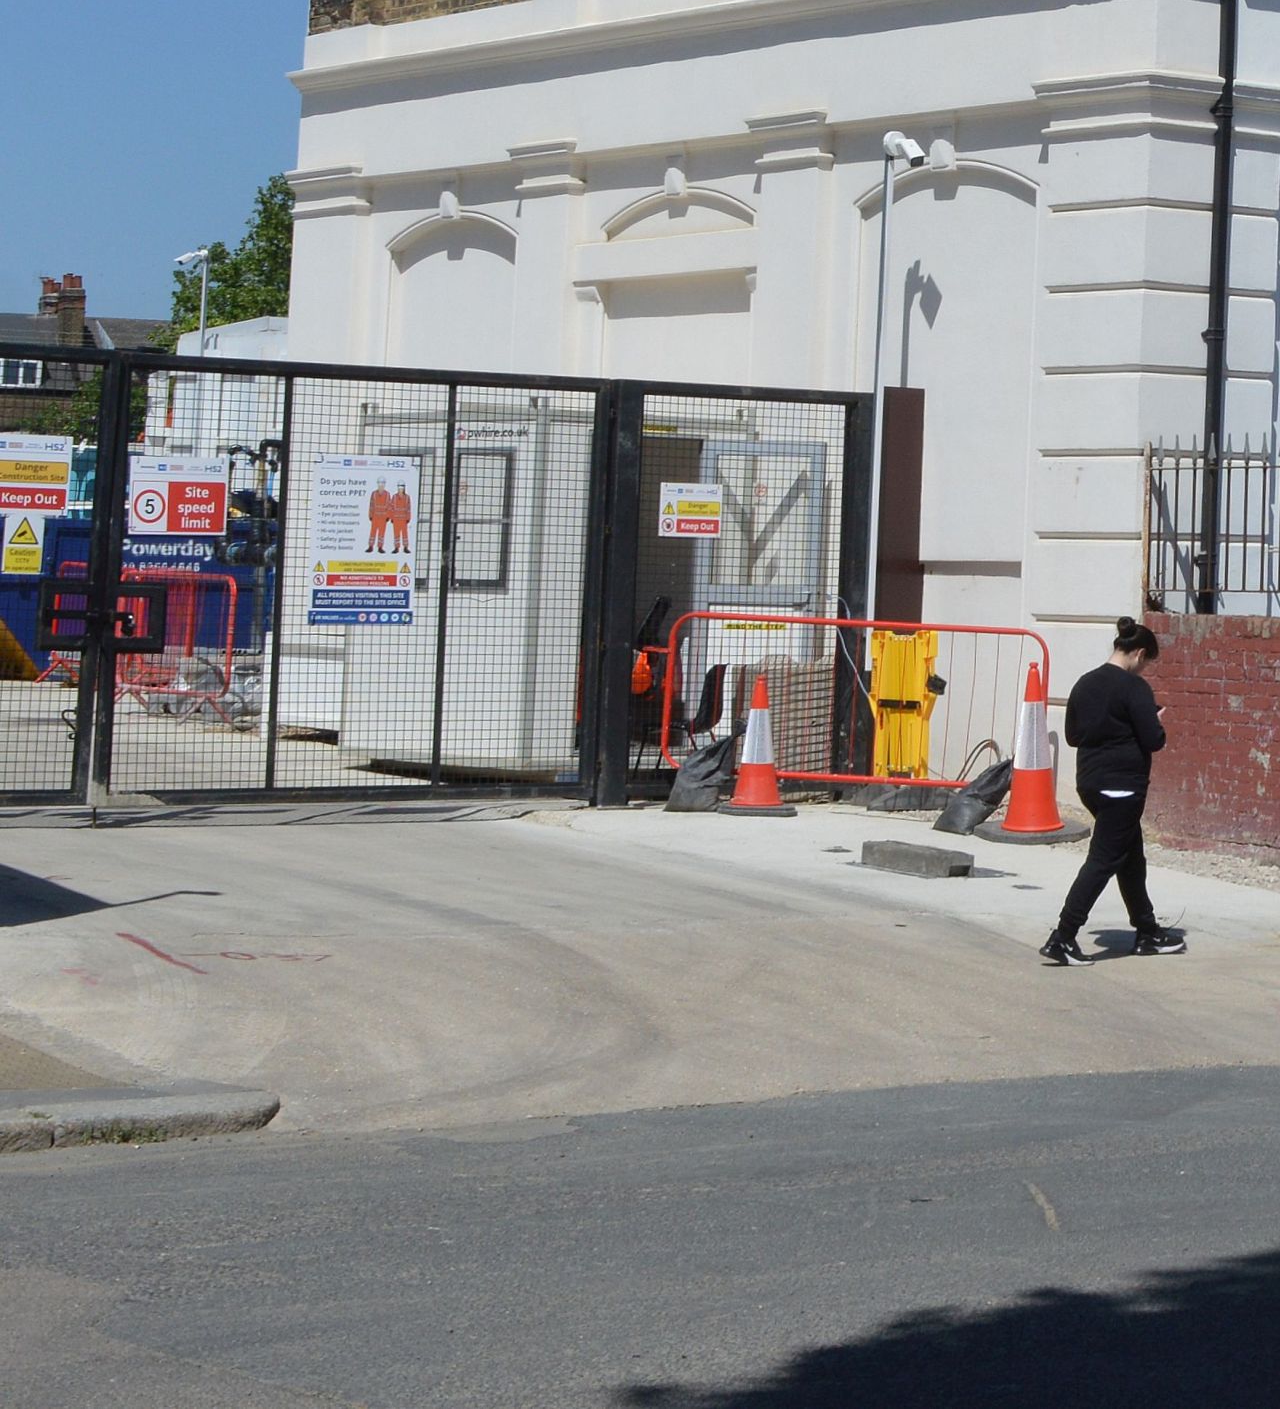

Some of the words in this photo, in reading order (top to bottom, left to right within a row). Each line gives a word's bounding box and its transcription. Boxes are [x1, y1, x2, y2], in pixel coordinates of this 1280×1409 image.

[44, 443, 65, 451] HS2
[15, 463, 48, 473] Danger
[387, 460, 405, 468] HS2
[332, 479, 346, 487] you
[185, 487, 209, 498] Site
[1, 492, 32, 505] Keep
[35, 493, 58, 505] Out
[144, 499, 155, 514] 5
[177, 502, 215, 515] speed
[181, 517, 211, 529] limit
[680, 522, 699, 532] Keep
